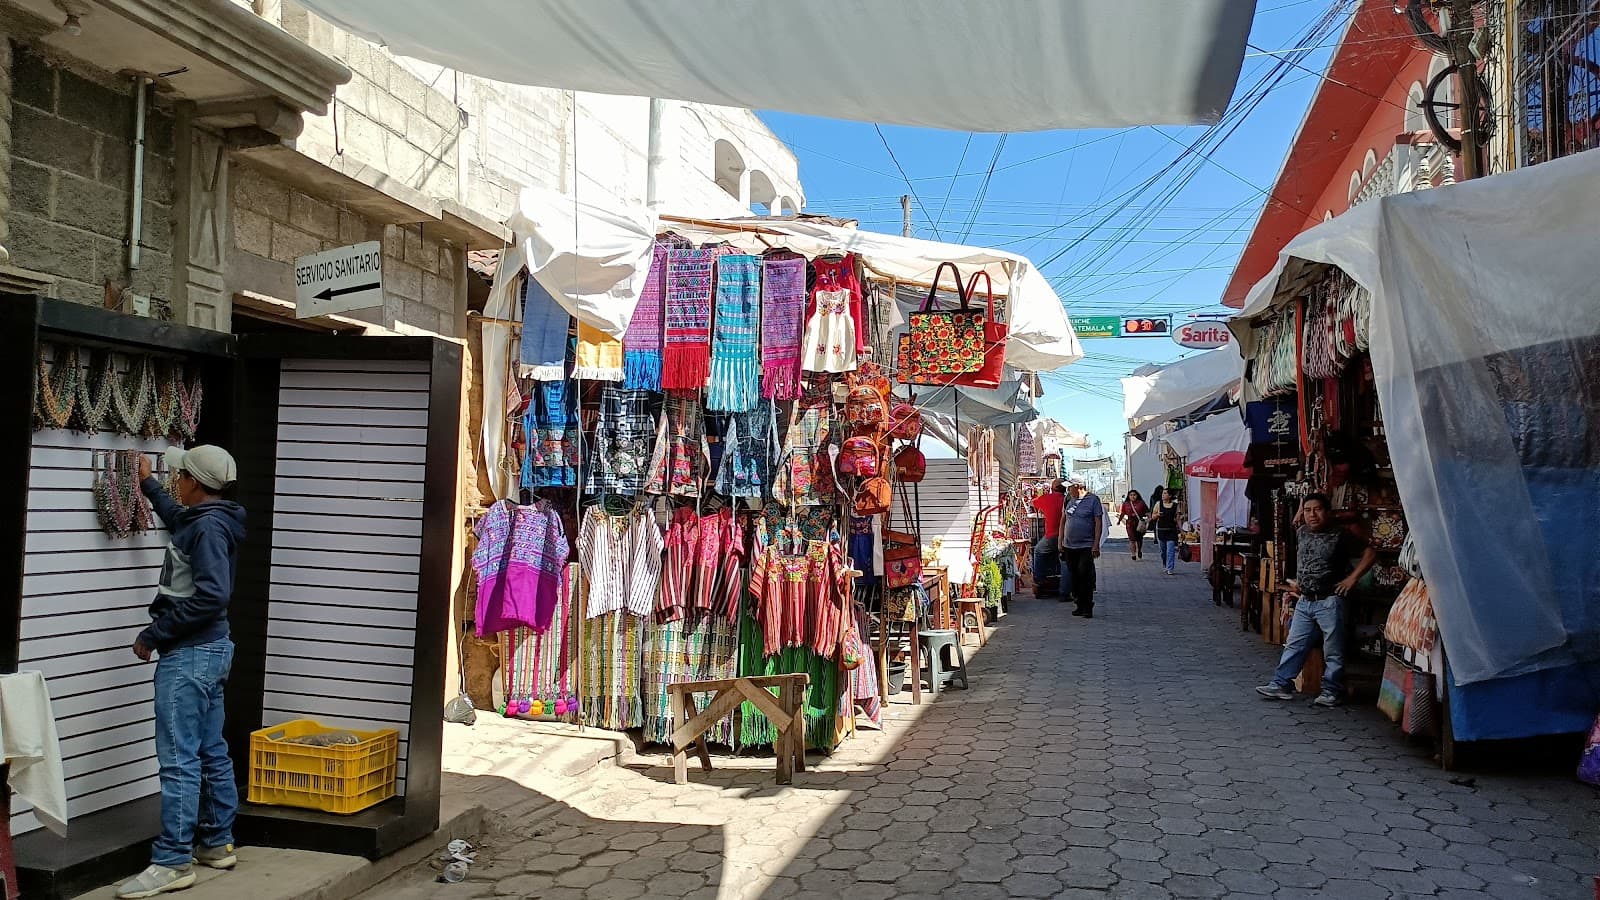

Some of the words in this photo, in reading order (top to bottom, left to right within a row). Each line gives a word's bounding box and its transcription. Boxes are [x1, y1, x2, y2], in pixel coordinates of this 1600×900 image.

[296, 261, 333, 287] SERVICIO
[335, 251, 380, 279] SANITARIO
[1181, 327, 1229, 343] Sarita
